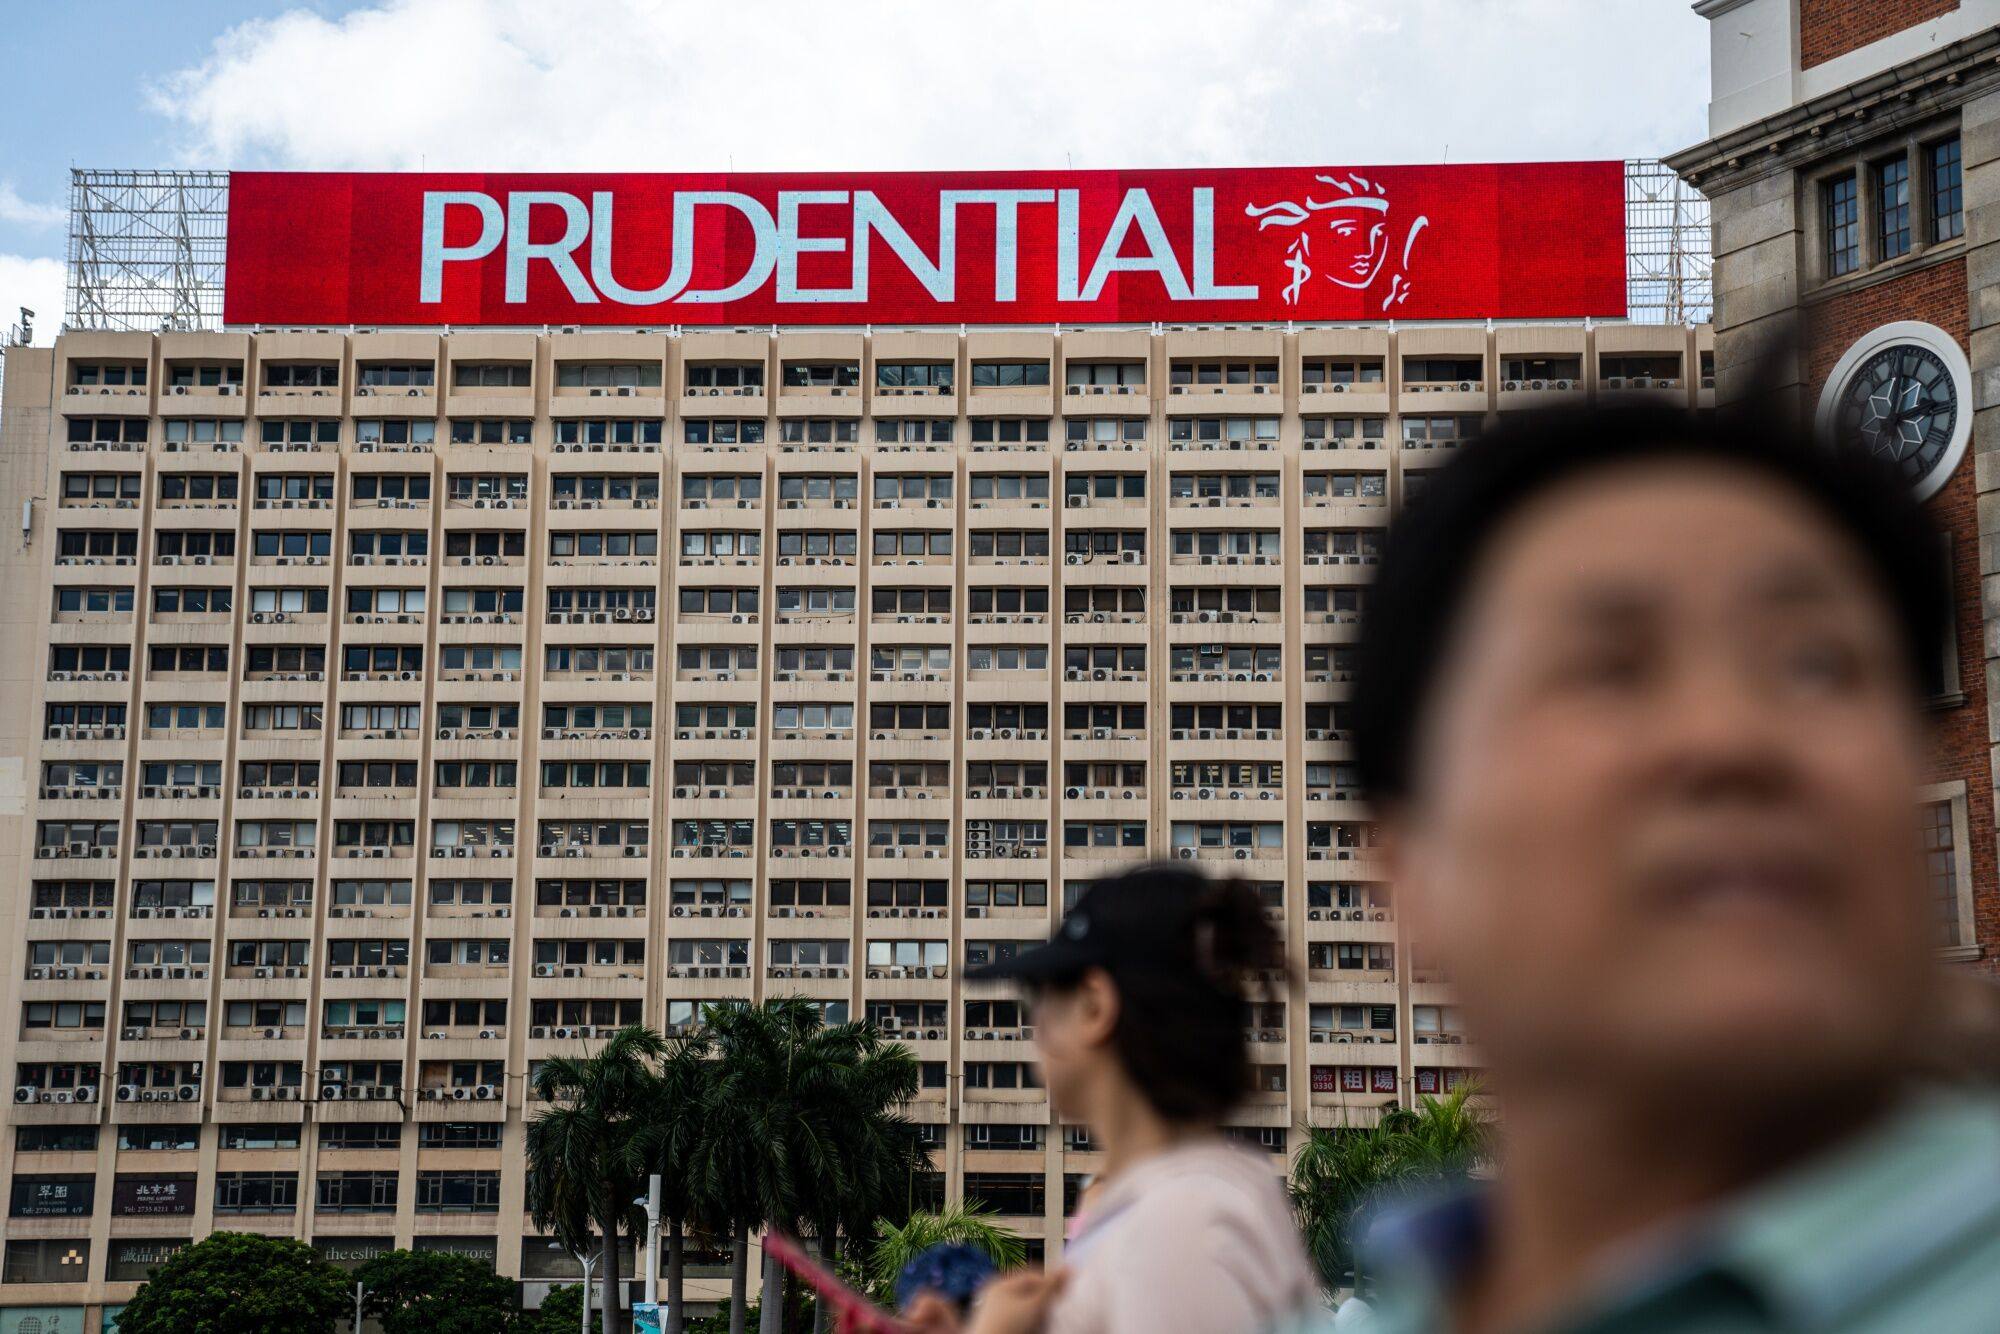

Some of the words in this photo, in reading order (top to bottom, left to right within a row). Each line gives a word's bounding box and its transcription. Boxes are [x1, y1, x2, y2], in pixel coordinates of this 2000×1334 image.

[420, 187, 1259, 305] PRUDENTIAL
[1312, 1082, 1333, 1090] 0330
[325, 1246, 348, 1260] the
[351, 1246, 384, 1260] eslit
[422, 1245, 493, 1259] okstore
